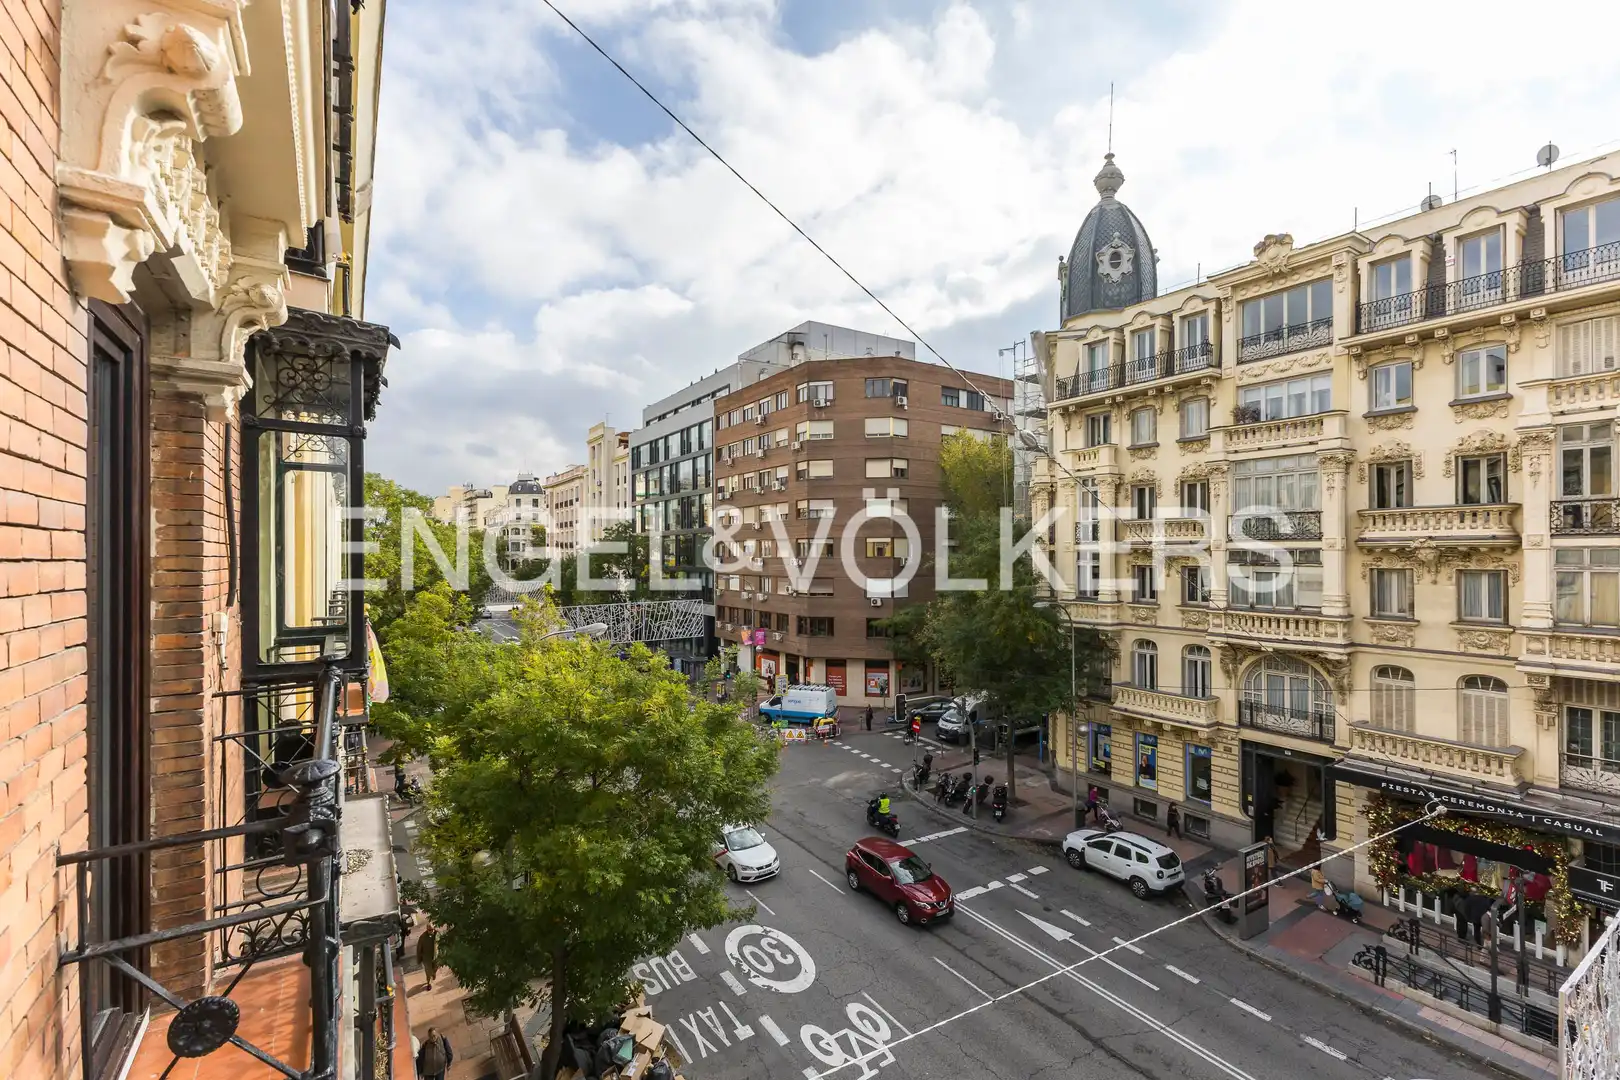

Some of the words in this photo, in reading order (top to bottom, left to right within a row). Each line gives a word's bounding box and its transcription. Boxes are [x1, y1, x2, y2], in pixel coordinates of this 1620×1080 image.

[1381, 782, 1425, 797] FIESTA
[1442, 795, 1524, 819] CEREMONIA
[1543, 817, 1604, 837] CASUAL
[632, 950, 698, 996] BUS
[742, 936, 796, 974] 30
[665, 1001, 755, 1064] TAXI
